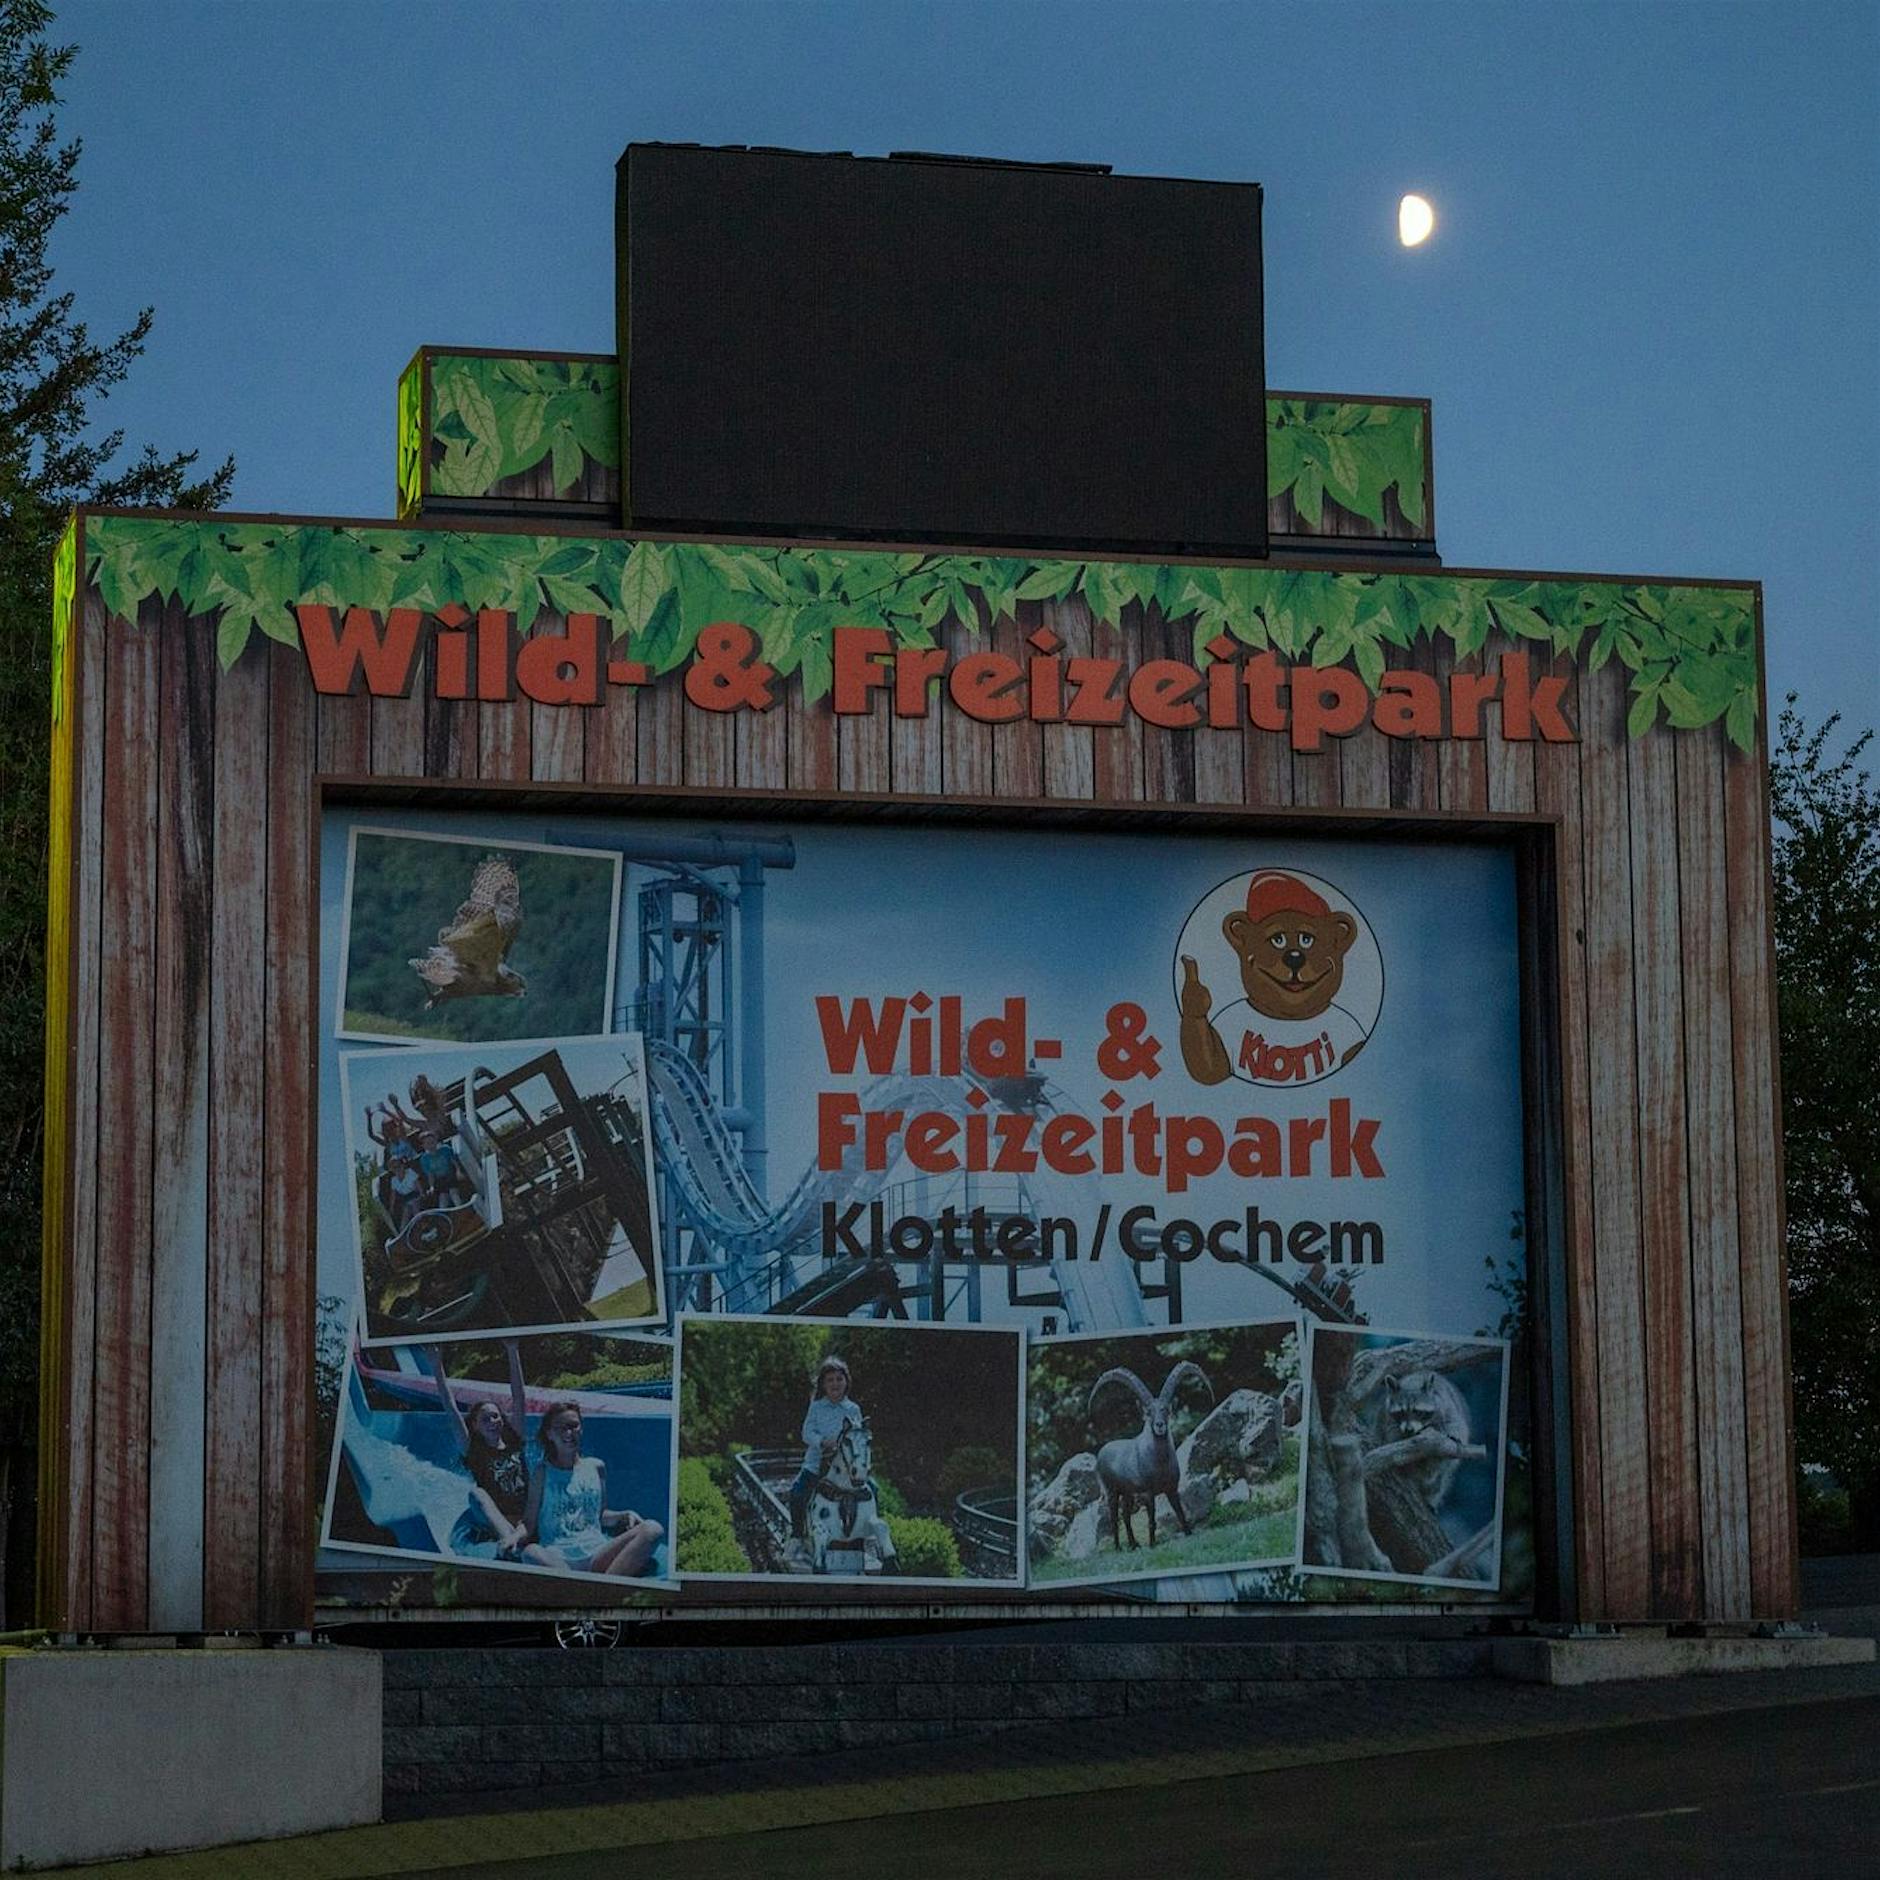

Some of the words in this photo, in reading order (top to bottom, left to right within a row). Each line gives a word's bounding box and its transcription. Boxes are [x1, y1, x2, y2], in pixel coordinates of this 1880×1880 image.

[297, 601, 652, 707] Wild-
[685, 622, 774, 713] &
[832, 626, 1579, 752] Freizeitpark
[815, 990, 1062, 1079] Wild-
[1097, 1002, 1162, 1080] &
[817, 1087, 1386, 1193] Freizeitpark
